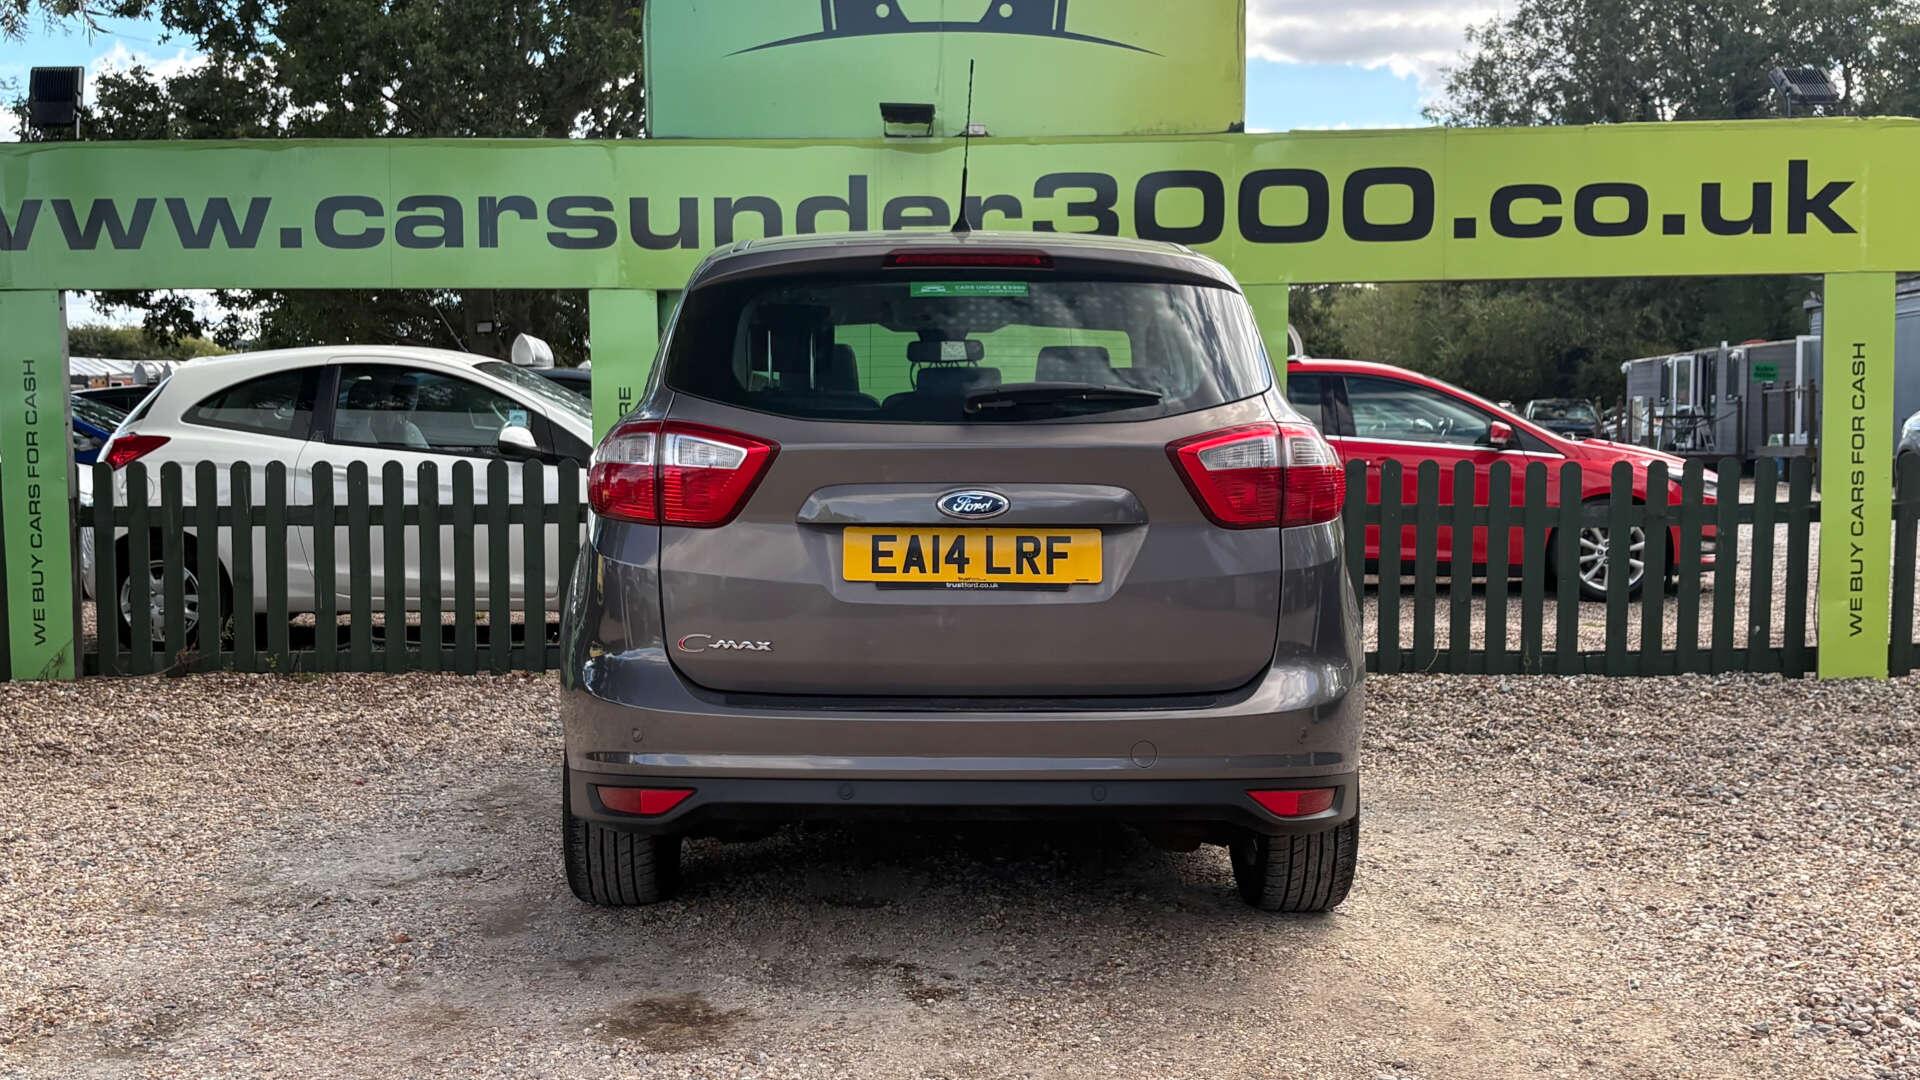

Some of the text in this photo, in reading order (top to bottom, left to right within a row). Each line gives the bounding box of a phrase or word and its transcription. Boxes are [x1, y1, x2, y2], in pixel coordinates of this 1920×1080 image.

[618, 386, 632, 417] RE
[23, 360, 46, 647] WE BUY CARS FOR CASH
[952, 495, 993, 513] Ford
[1850, 343, 1866, 637] WE BUY CARS FOR CASH
[871, 534, 1072, 575] EA14 LRF
